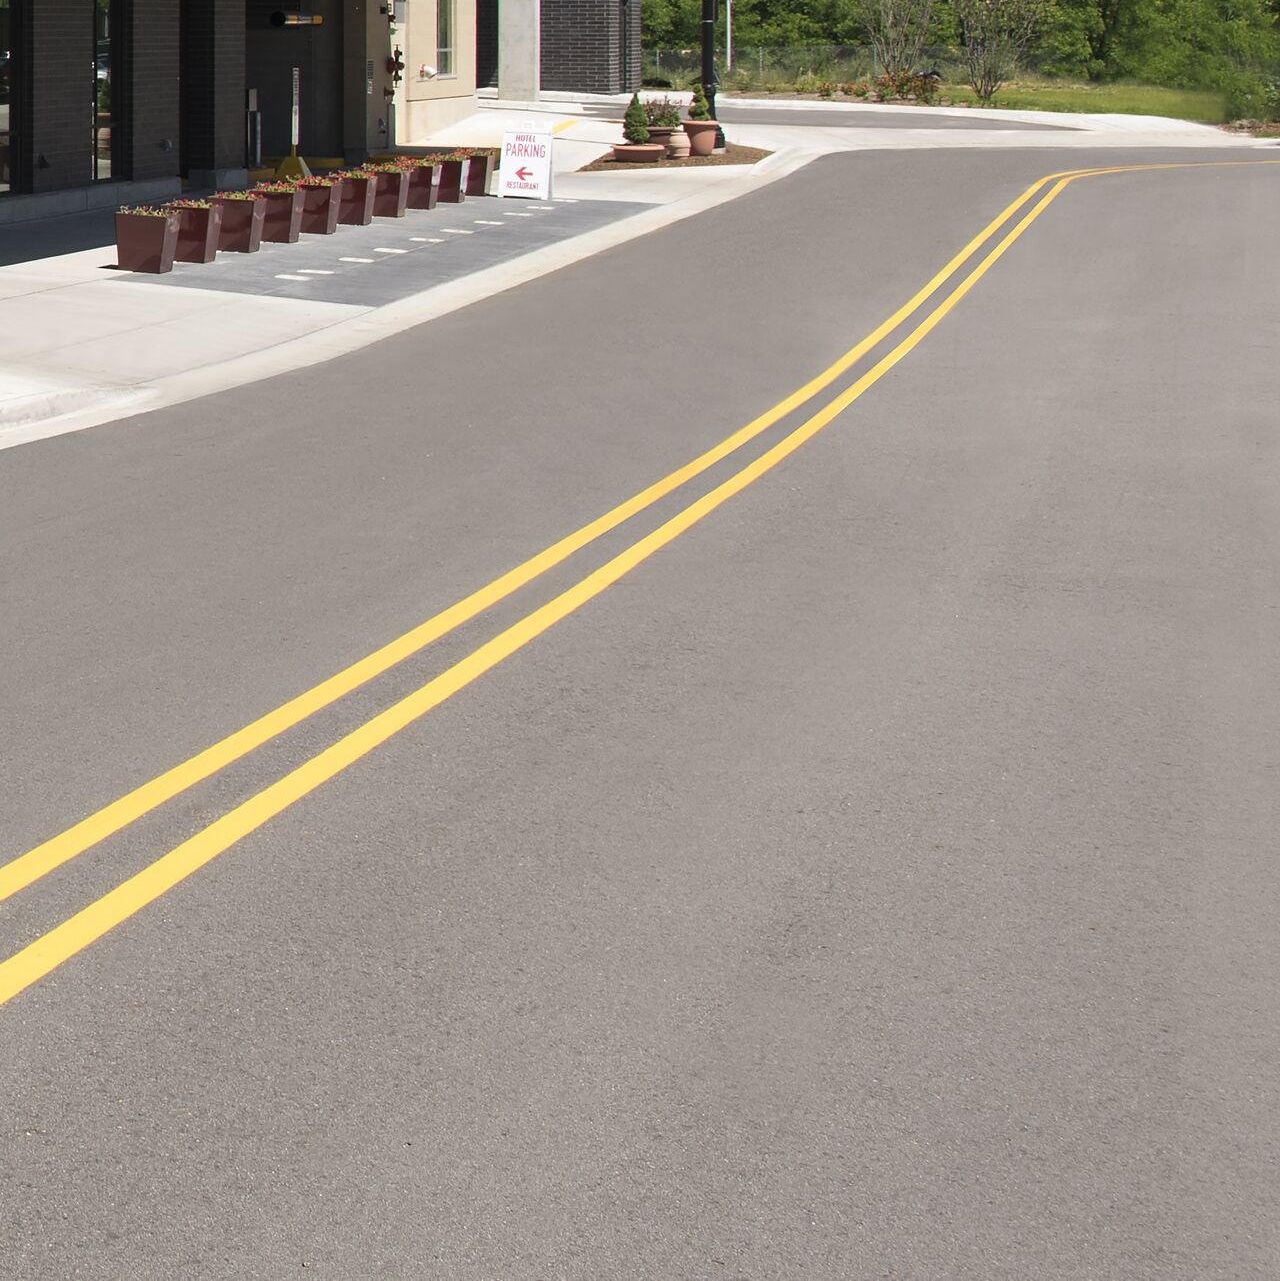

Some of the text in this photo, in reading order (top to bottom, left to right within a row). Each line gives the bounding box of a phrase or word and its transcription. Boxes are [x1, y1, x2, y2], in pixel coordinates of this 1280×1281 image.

[515, 134, 536, 143] HOTEL
[505, 143, 546, 158] PARKING
[506, 181, 539, 191] RESTAURANT
